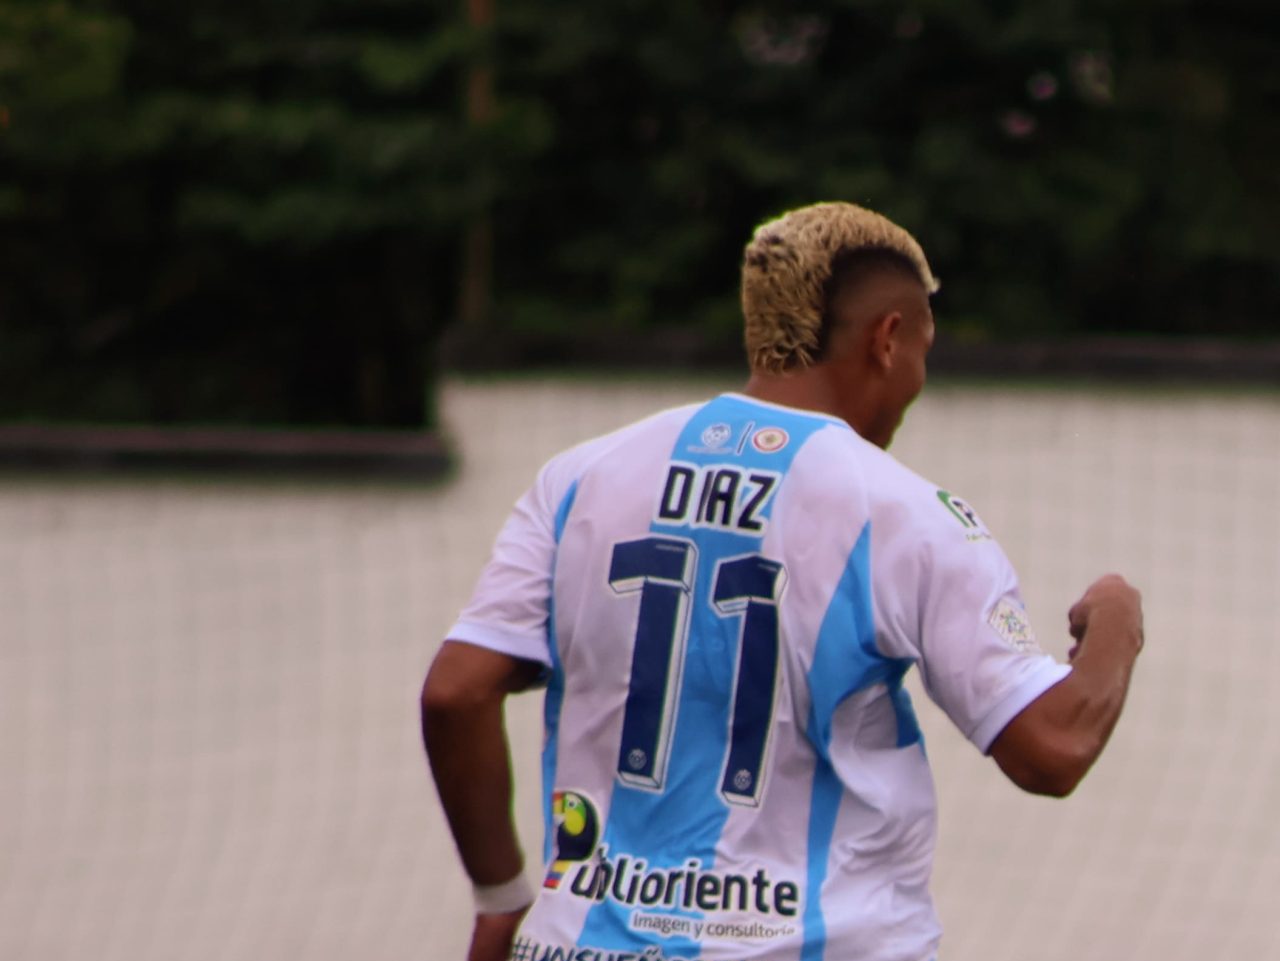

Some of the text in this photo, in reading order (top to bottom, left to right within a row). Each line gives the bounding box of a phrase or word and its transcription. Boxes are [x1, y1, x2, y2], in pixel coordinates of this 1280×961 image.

[658, 465, 776, 531] DIAZ
[609, 537, 787, 808] 11
[633, 912, 690, 935] imagen
[693, 923, 704, 938] y
